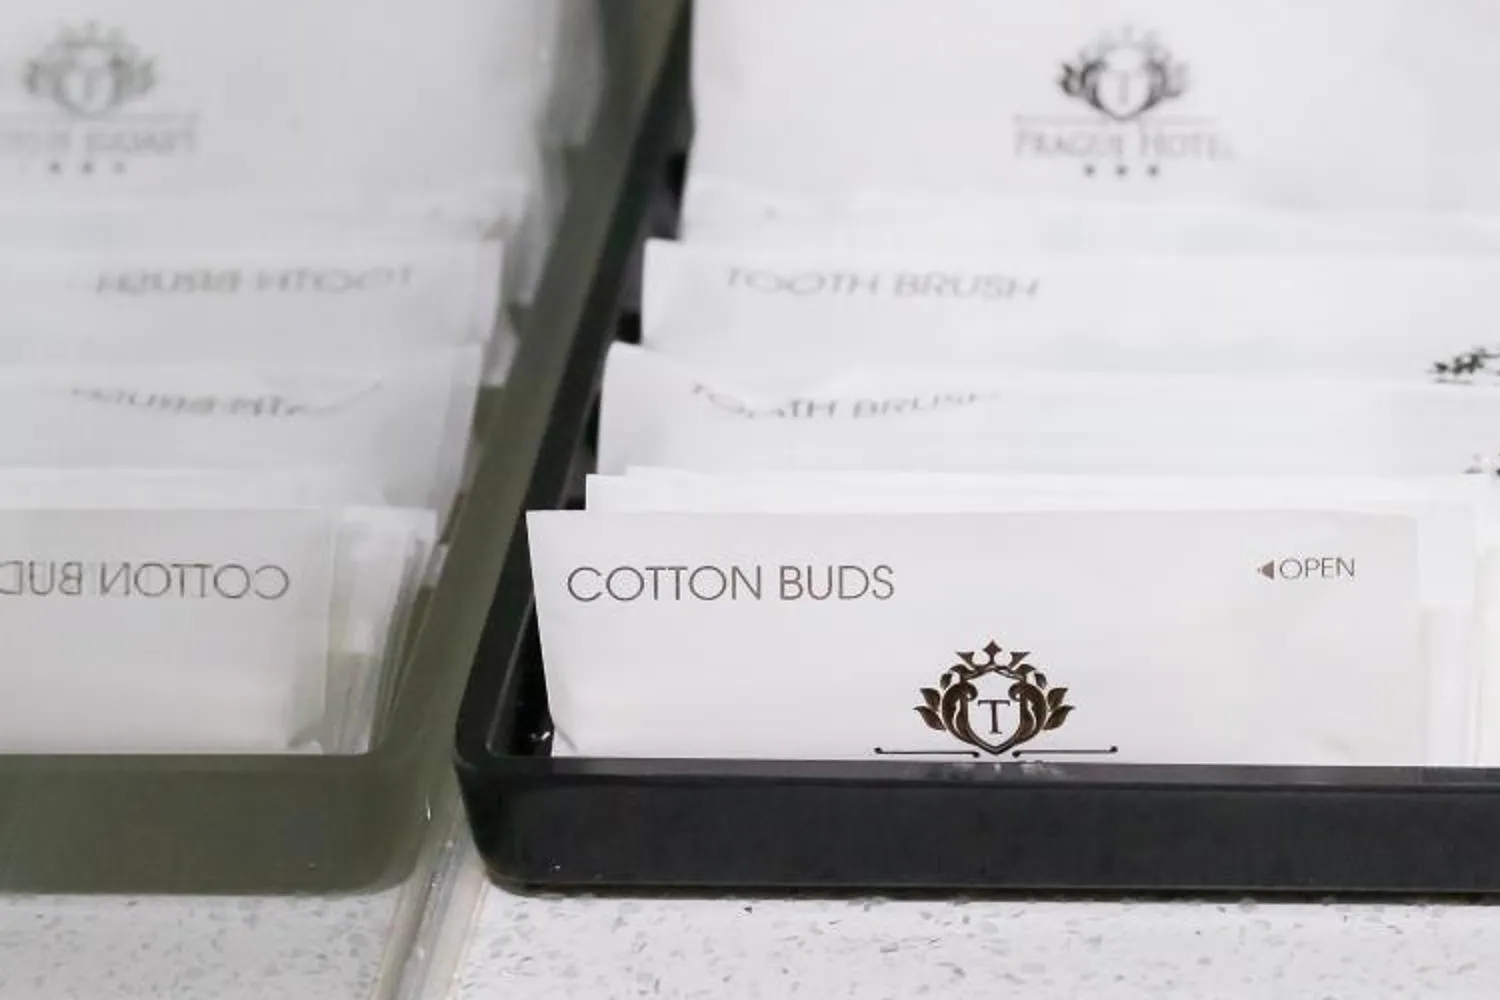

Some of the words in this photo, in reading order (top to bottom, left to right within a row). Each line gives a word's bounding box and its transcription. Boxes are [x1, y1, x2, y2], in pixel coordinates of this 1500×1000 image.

[726, 266, 881, 297] TOOTH
[892, 270, 1040, 299] BRUSH
[566, 565, 762, 602] COTTON
[779, 564, 895, 601] BUDS
[1278, 556, 1356, 580] OPEN
[977, 699, 1011, 735] T
